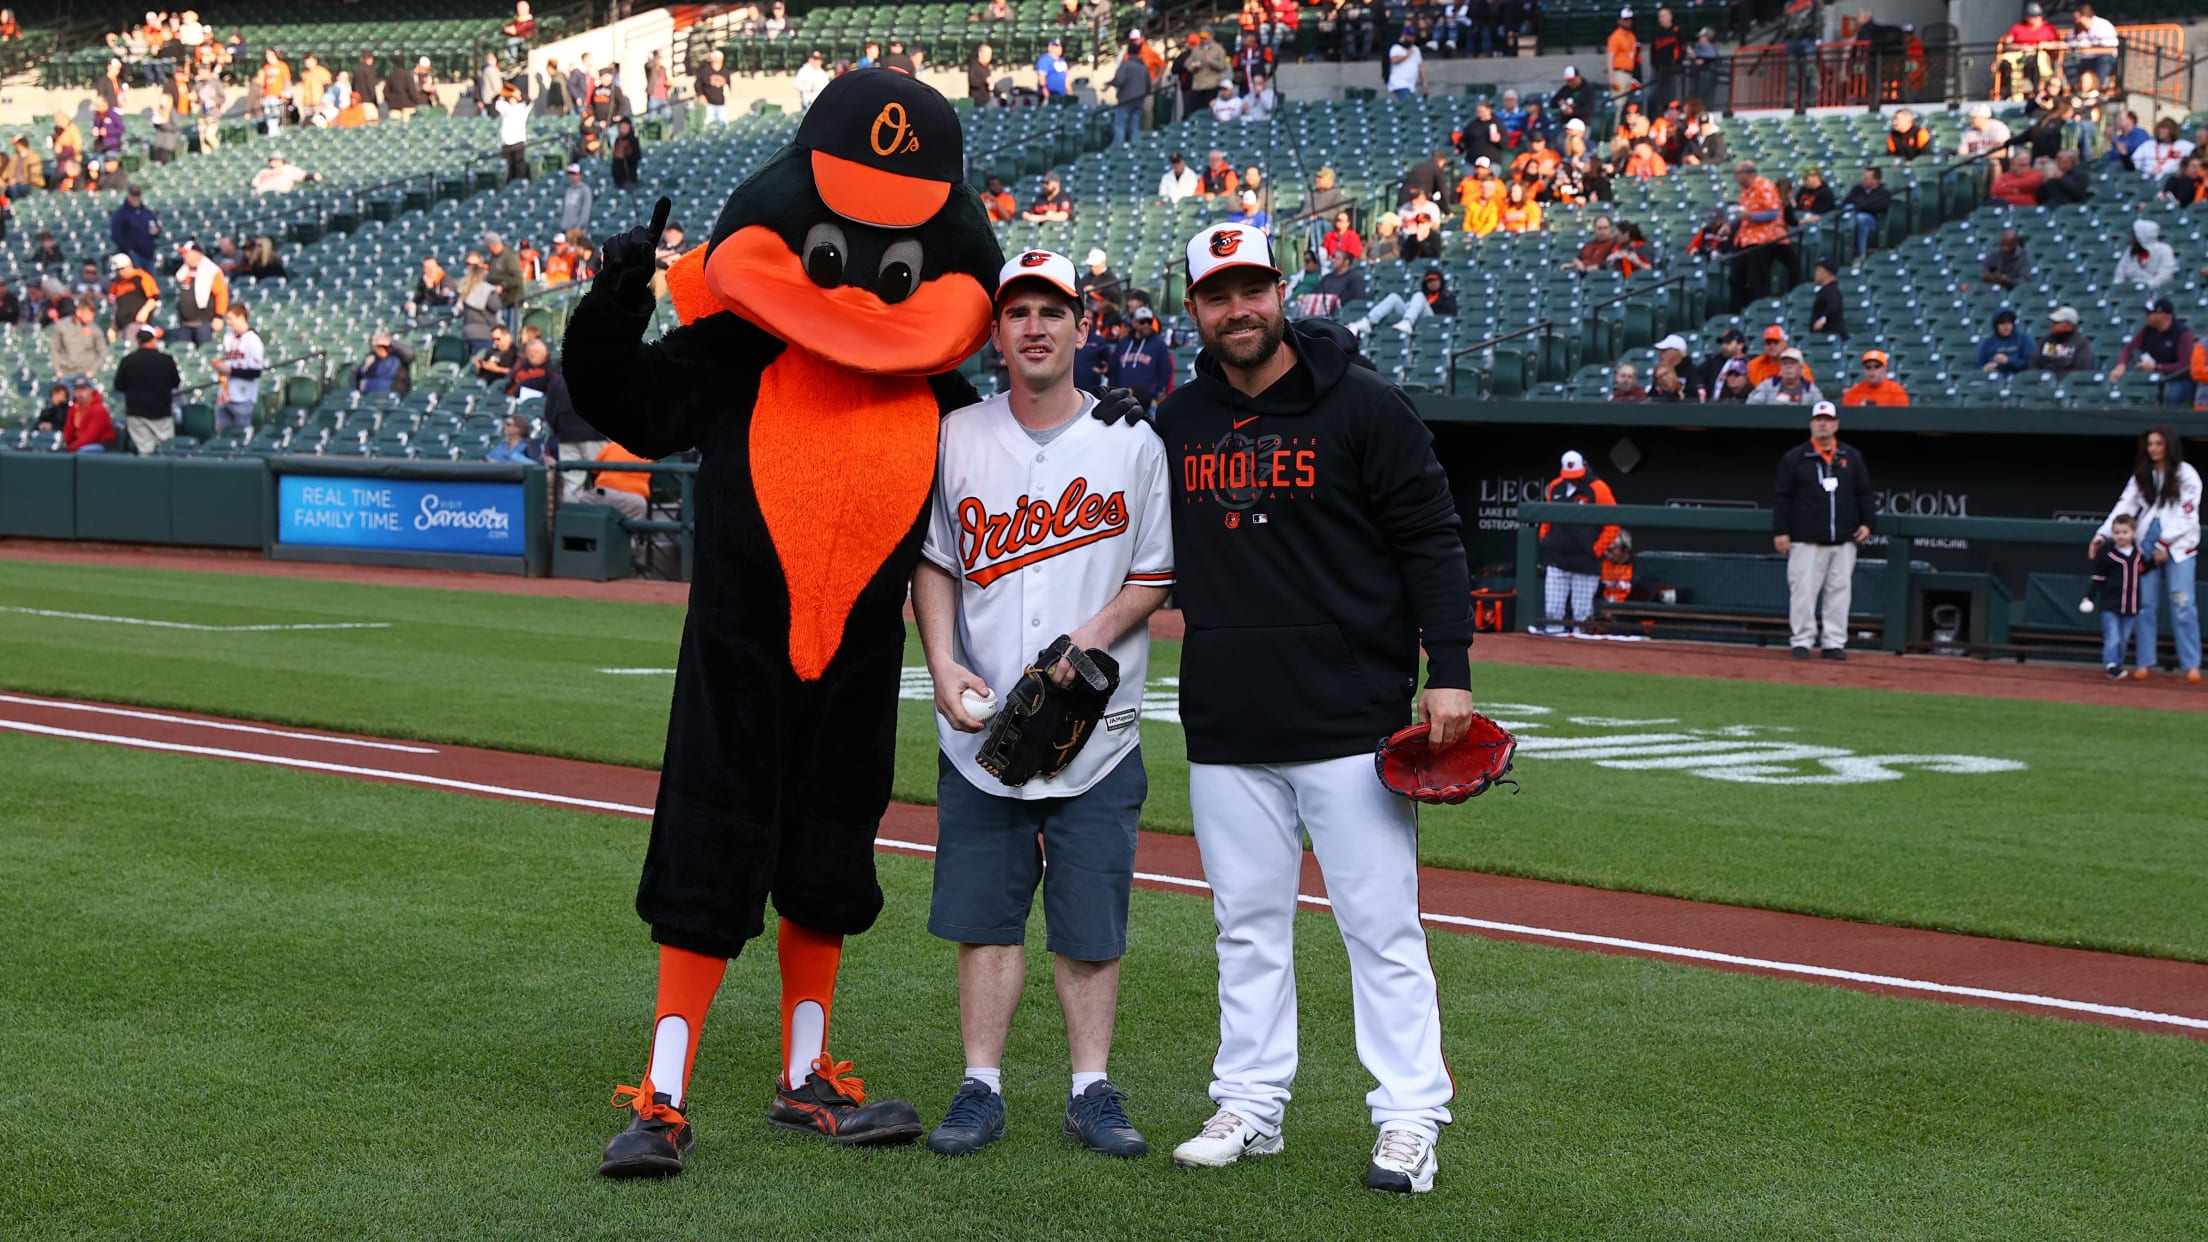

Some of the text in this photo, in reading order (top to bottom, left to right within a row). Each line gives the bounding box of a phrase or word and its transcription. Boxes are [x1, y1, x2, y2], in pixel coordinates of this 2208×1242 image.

[870, 102, 920, 156] O's
[1184, 450, 1316, 492] ORIOLES
[302, 486, 396, 509] REAL TIME.
[414, 494, 509, 531] Sarasota
[1478, 507, 1519, 518] LAKE ER
[294, 508, 404, 532] FAMILY TIME.
[958, 476, 1130, 573] Orioles
